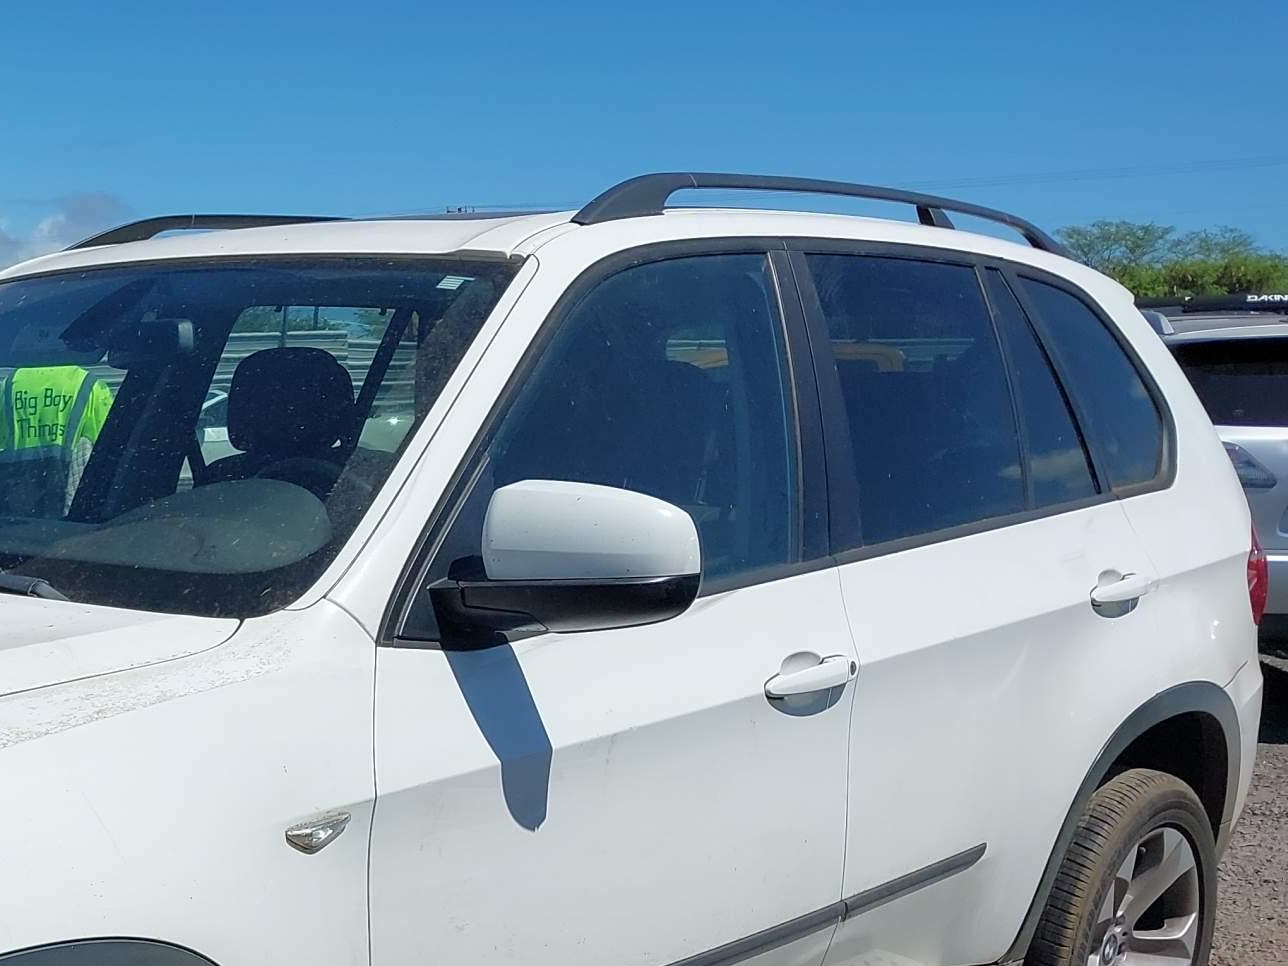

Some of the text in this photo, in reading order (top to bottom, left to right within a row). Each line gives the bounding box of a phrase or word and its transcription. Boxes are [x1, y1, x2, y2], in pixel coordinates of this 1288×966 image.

[15, 387, 73, 416] Big Boy
[16, 416, 66, 442] Things
